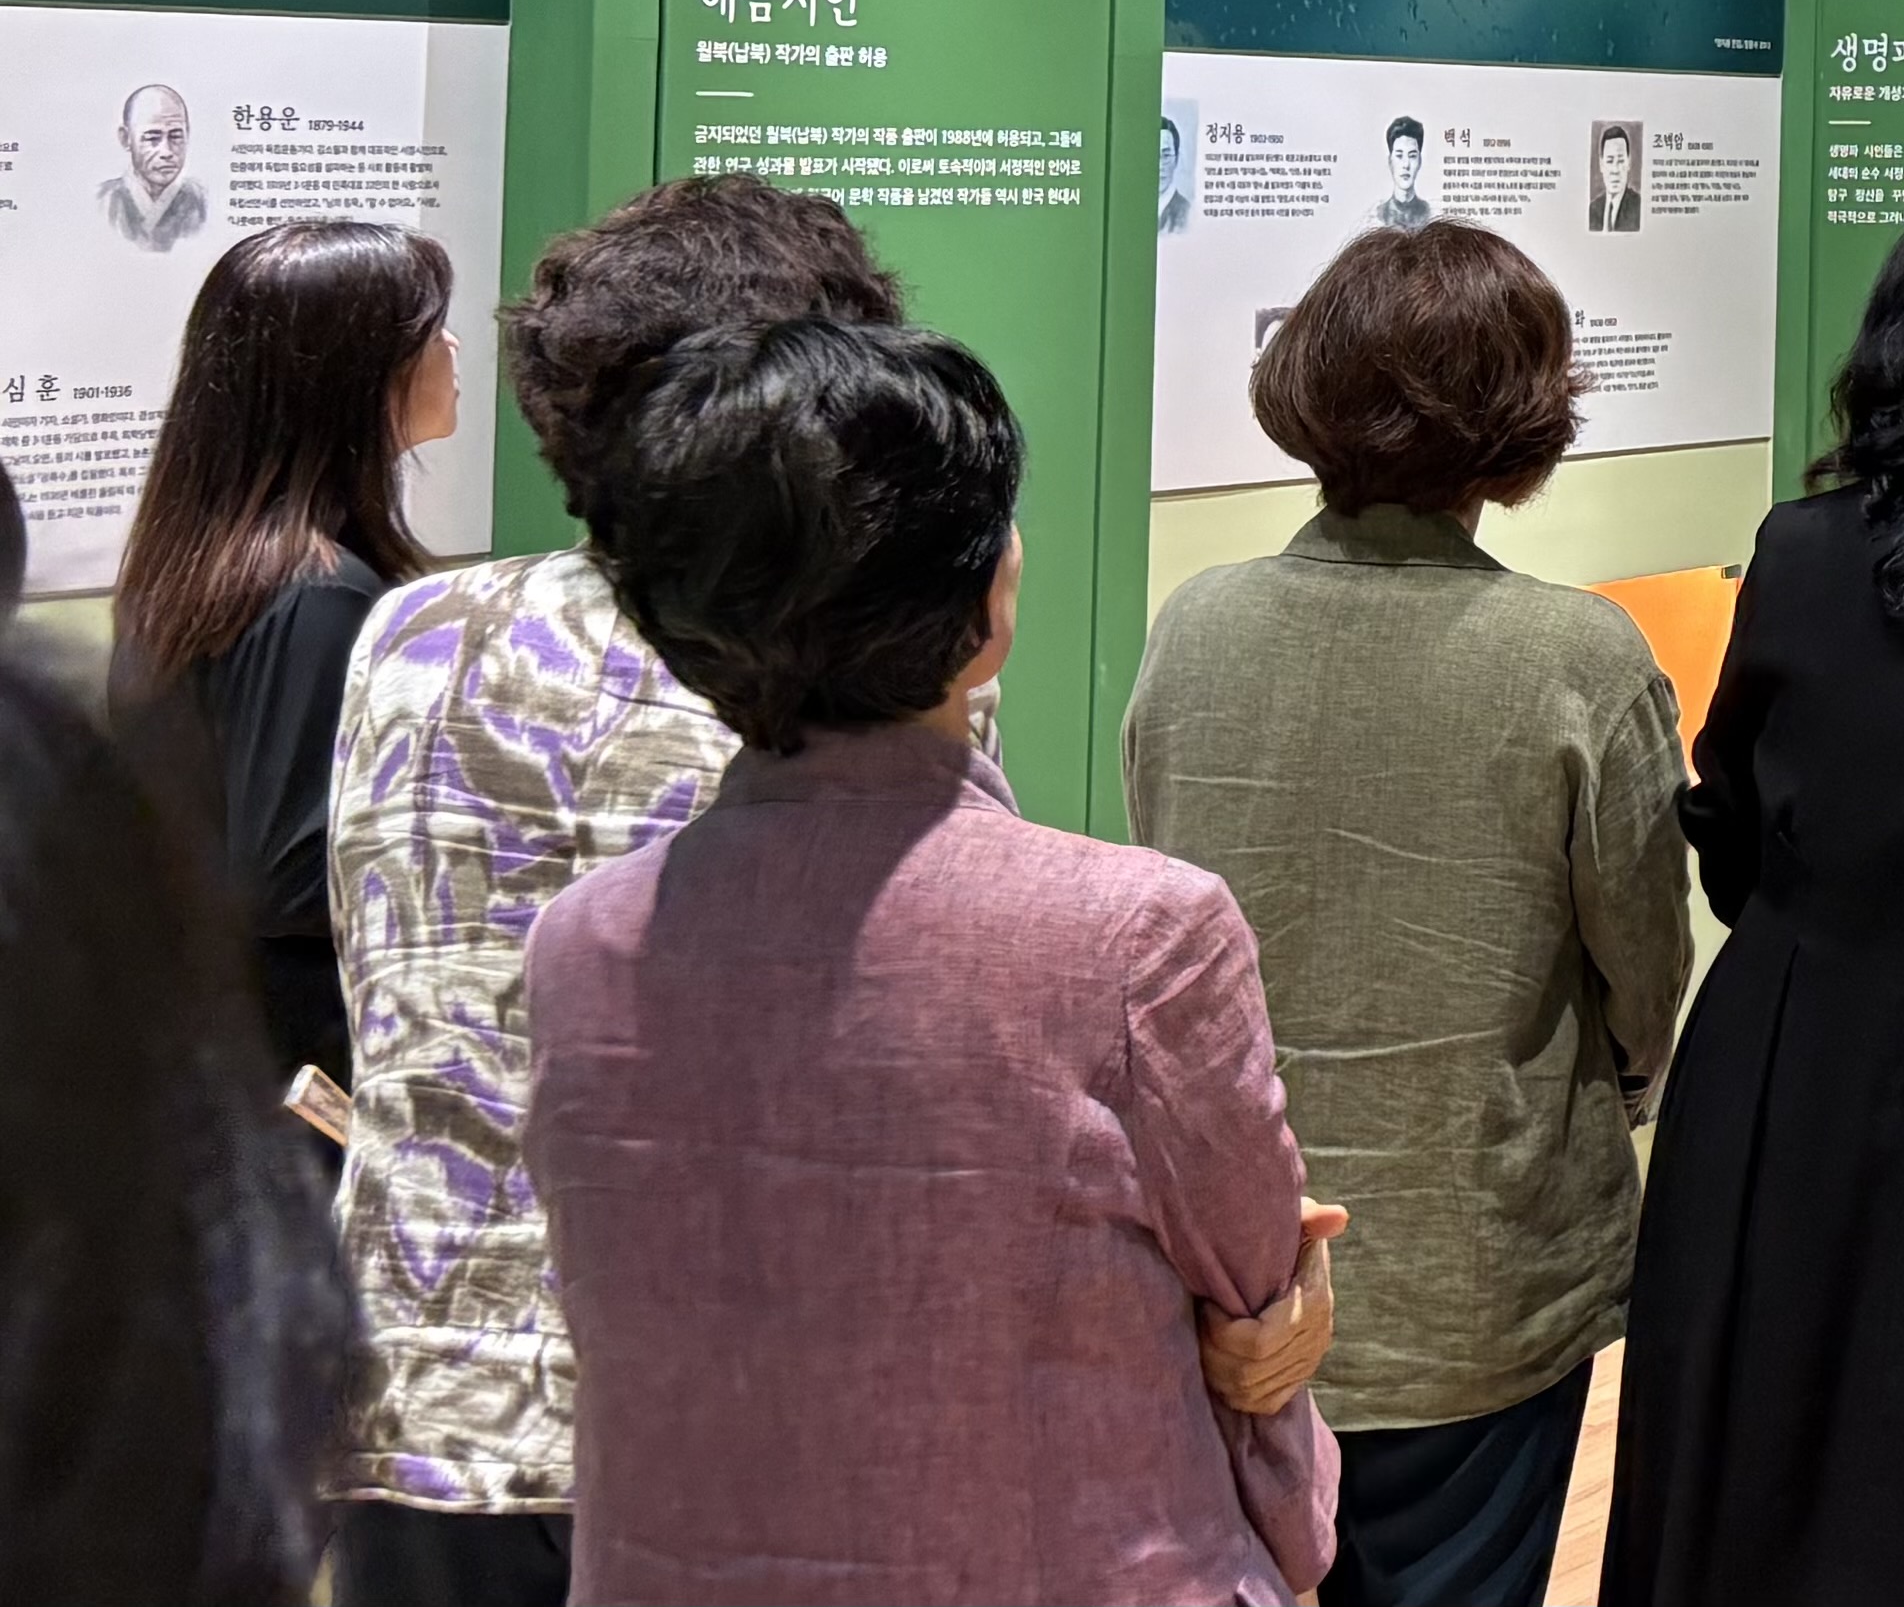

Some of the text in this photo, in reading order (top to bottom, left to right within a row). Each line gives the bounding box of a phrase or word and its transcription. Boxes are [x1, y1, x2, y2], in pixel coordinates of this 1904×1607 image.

[232, 104, 300, 131] 한용운
[2, 375, 25, 403] 심
[35, 374, 60, 401] 훈
